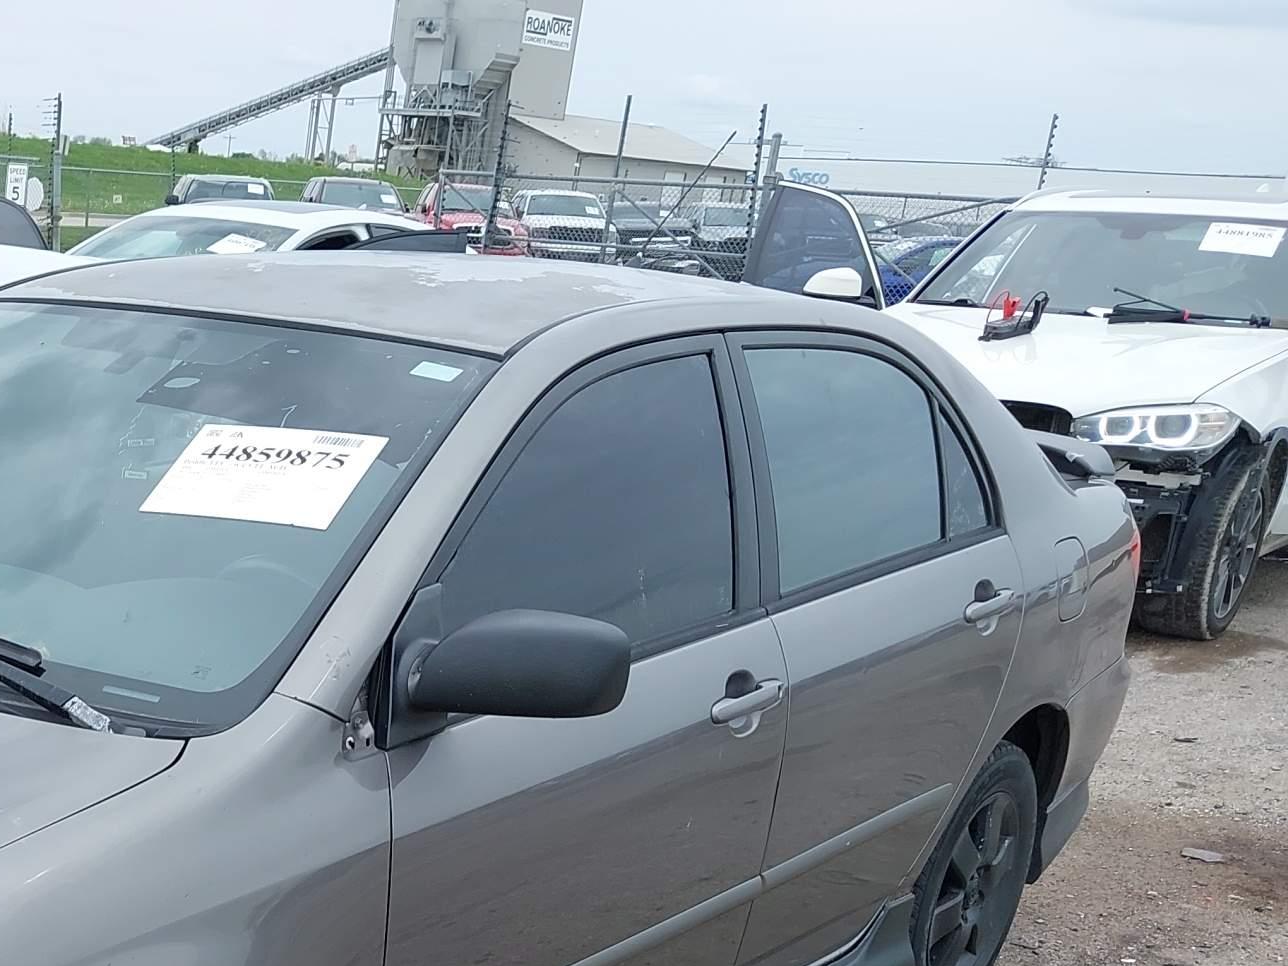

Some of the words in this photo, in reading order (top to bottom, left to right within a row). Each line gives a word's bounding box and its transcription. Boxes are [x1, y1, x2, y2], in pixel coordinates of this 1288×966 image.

[526, 16, 572, 36] ROANOKE
[9, 167, 26, 175] SPEED
[12, 186, 20, 201] 5
[201, 443, 350, 470] 44859875
